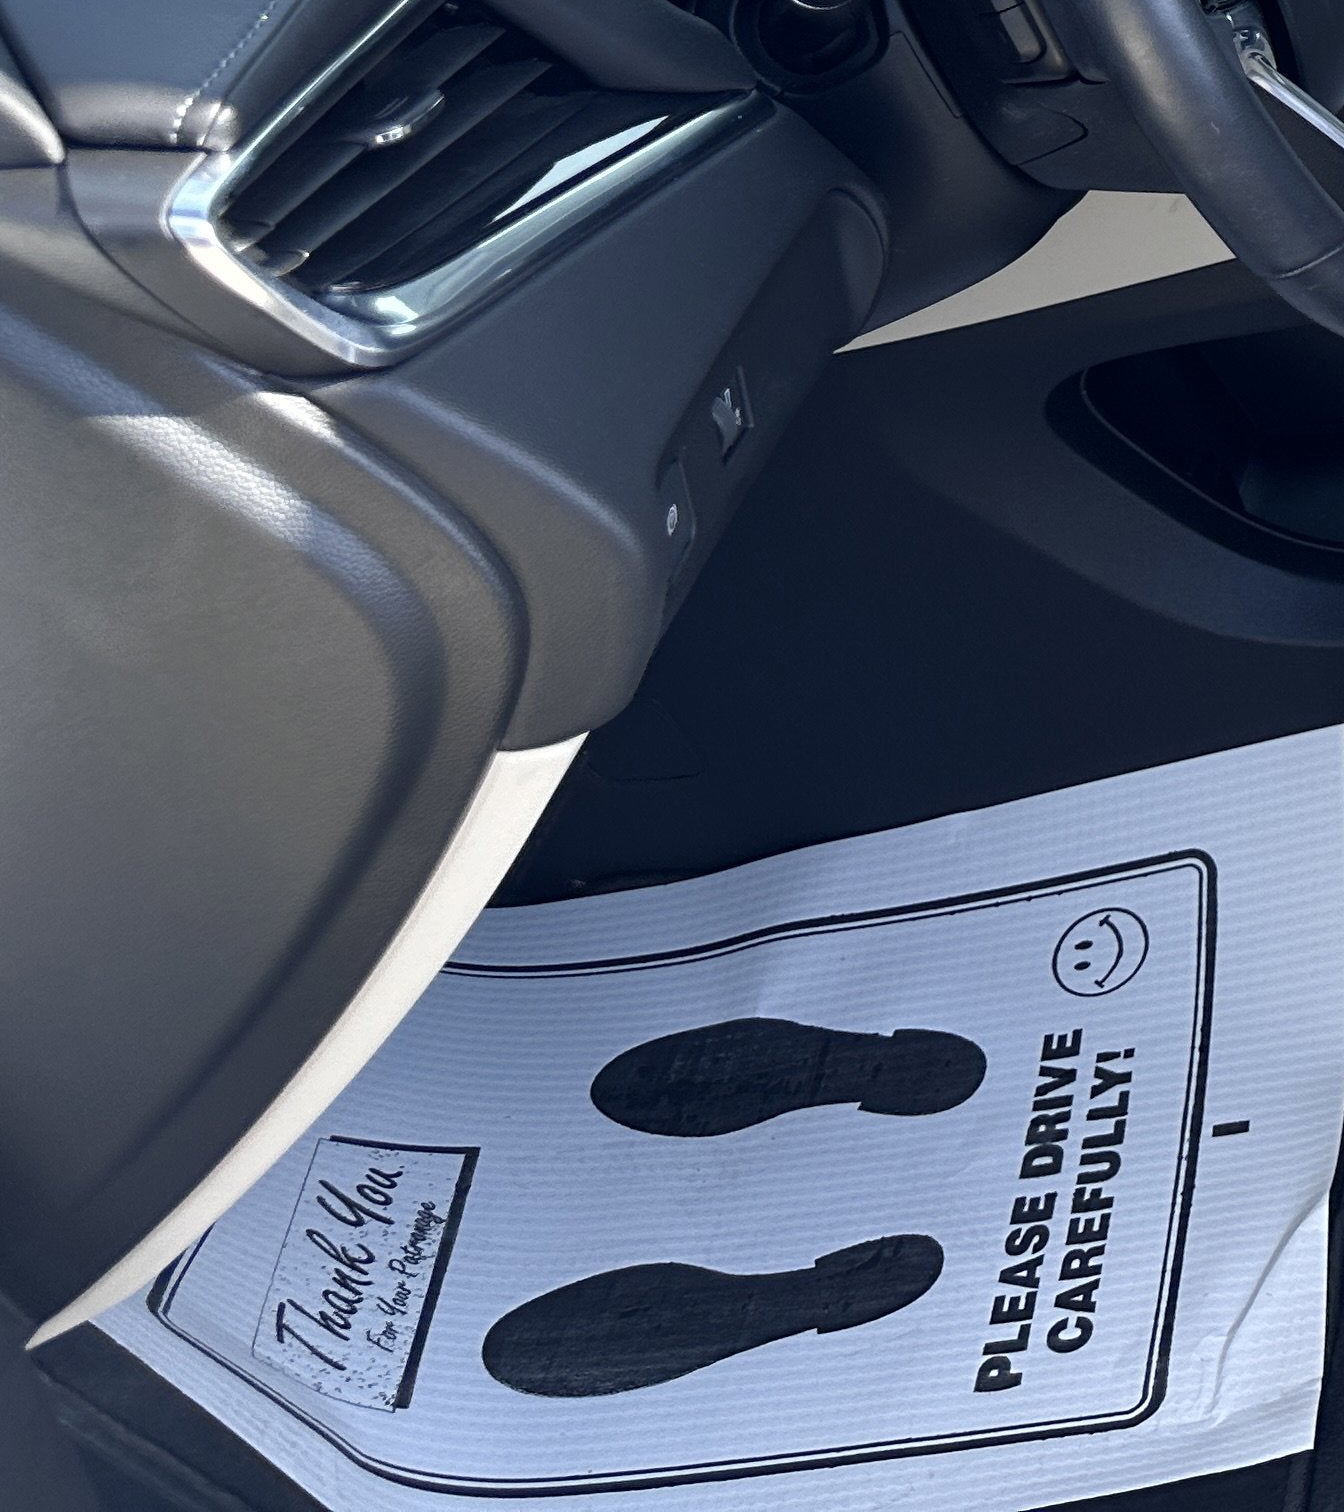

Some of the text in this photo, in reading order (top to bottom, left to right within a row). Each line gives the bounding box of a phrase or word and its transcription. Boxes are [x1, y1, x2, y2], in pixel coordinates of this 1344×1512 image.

[275, 1167, 404, 1371] Thank You
[366, 1200, 447, 1353] For Your Patronage
[973, 1028, 1083, 1393] PLEASE DRIVE
[1046, 1047, 1136, 1354] CAREFULLY!
